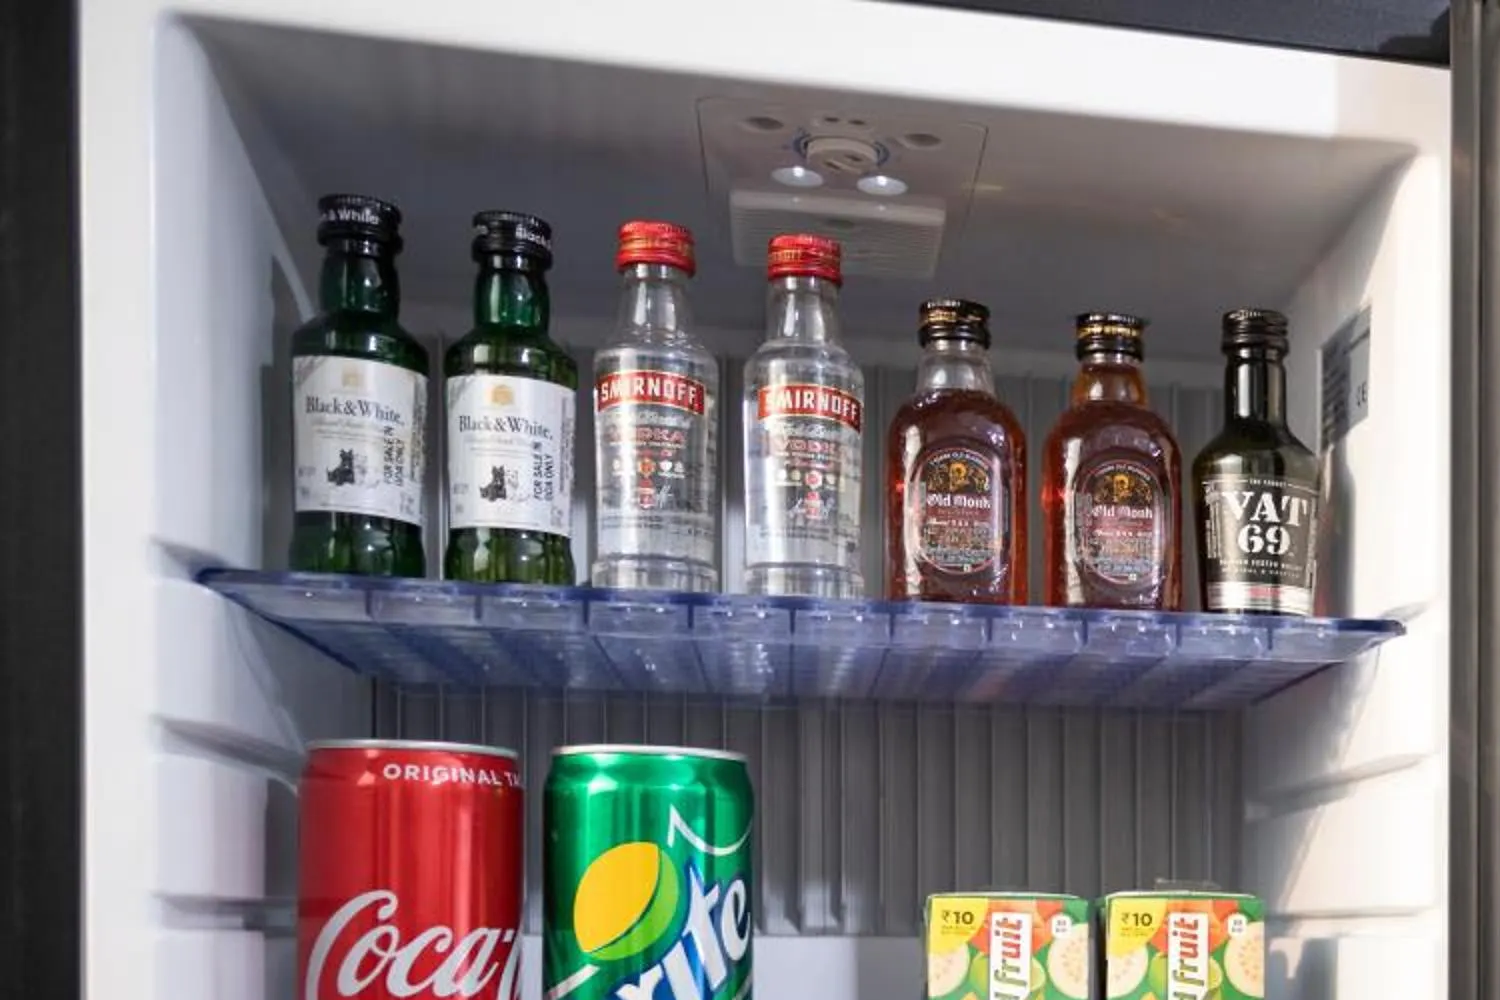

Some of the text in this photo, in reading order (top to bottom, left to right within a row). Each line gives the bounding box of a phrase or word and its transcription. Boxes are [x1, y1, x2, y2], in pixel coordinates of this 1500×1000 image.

[601, 376, 698, 406] SMIRNOFF
[764, 388, 859, 420] SMIRNOFF
[926, 493, 991, 509] Old Monk
[1091, 504, 1153, 519] Old Monk
[1222, 490, 1308, 527] VAT
[1237, 523, 1291, 555] 69
[383, 763, 503, 786] ORIGINAL
[994, 918, 1027, 987] fruit
[1172, 917, 1205, 986] fruit
